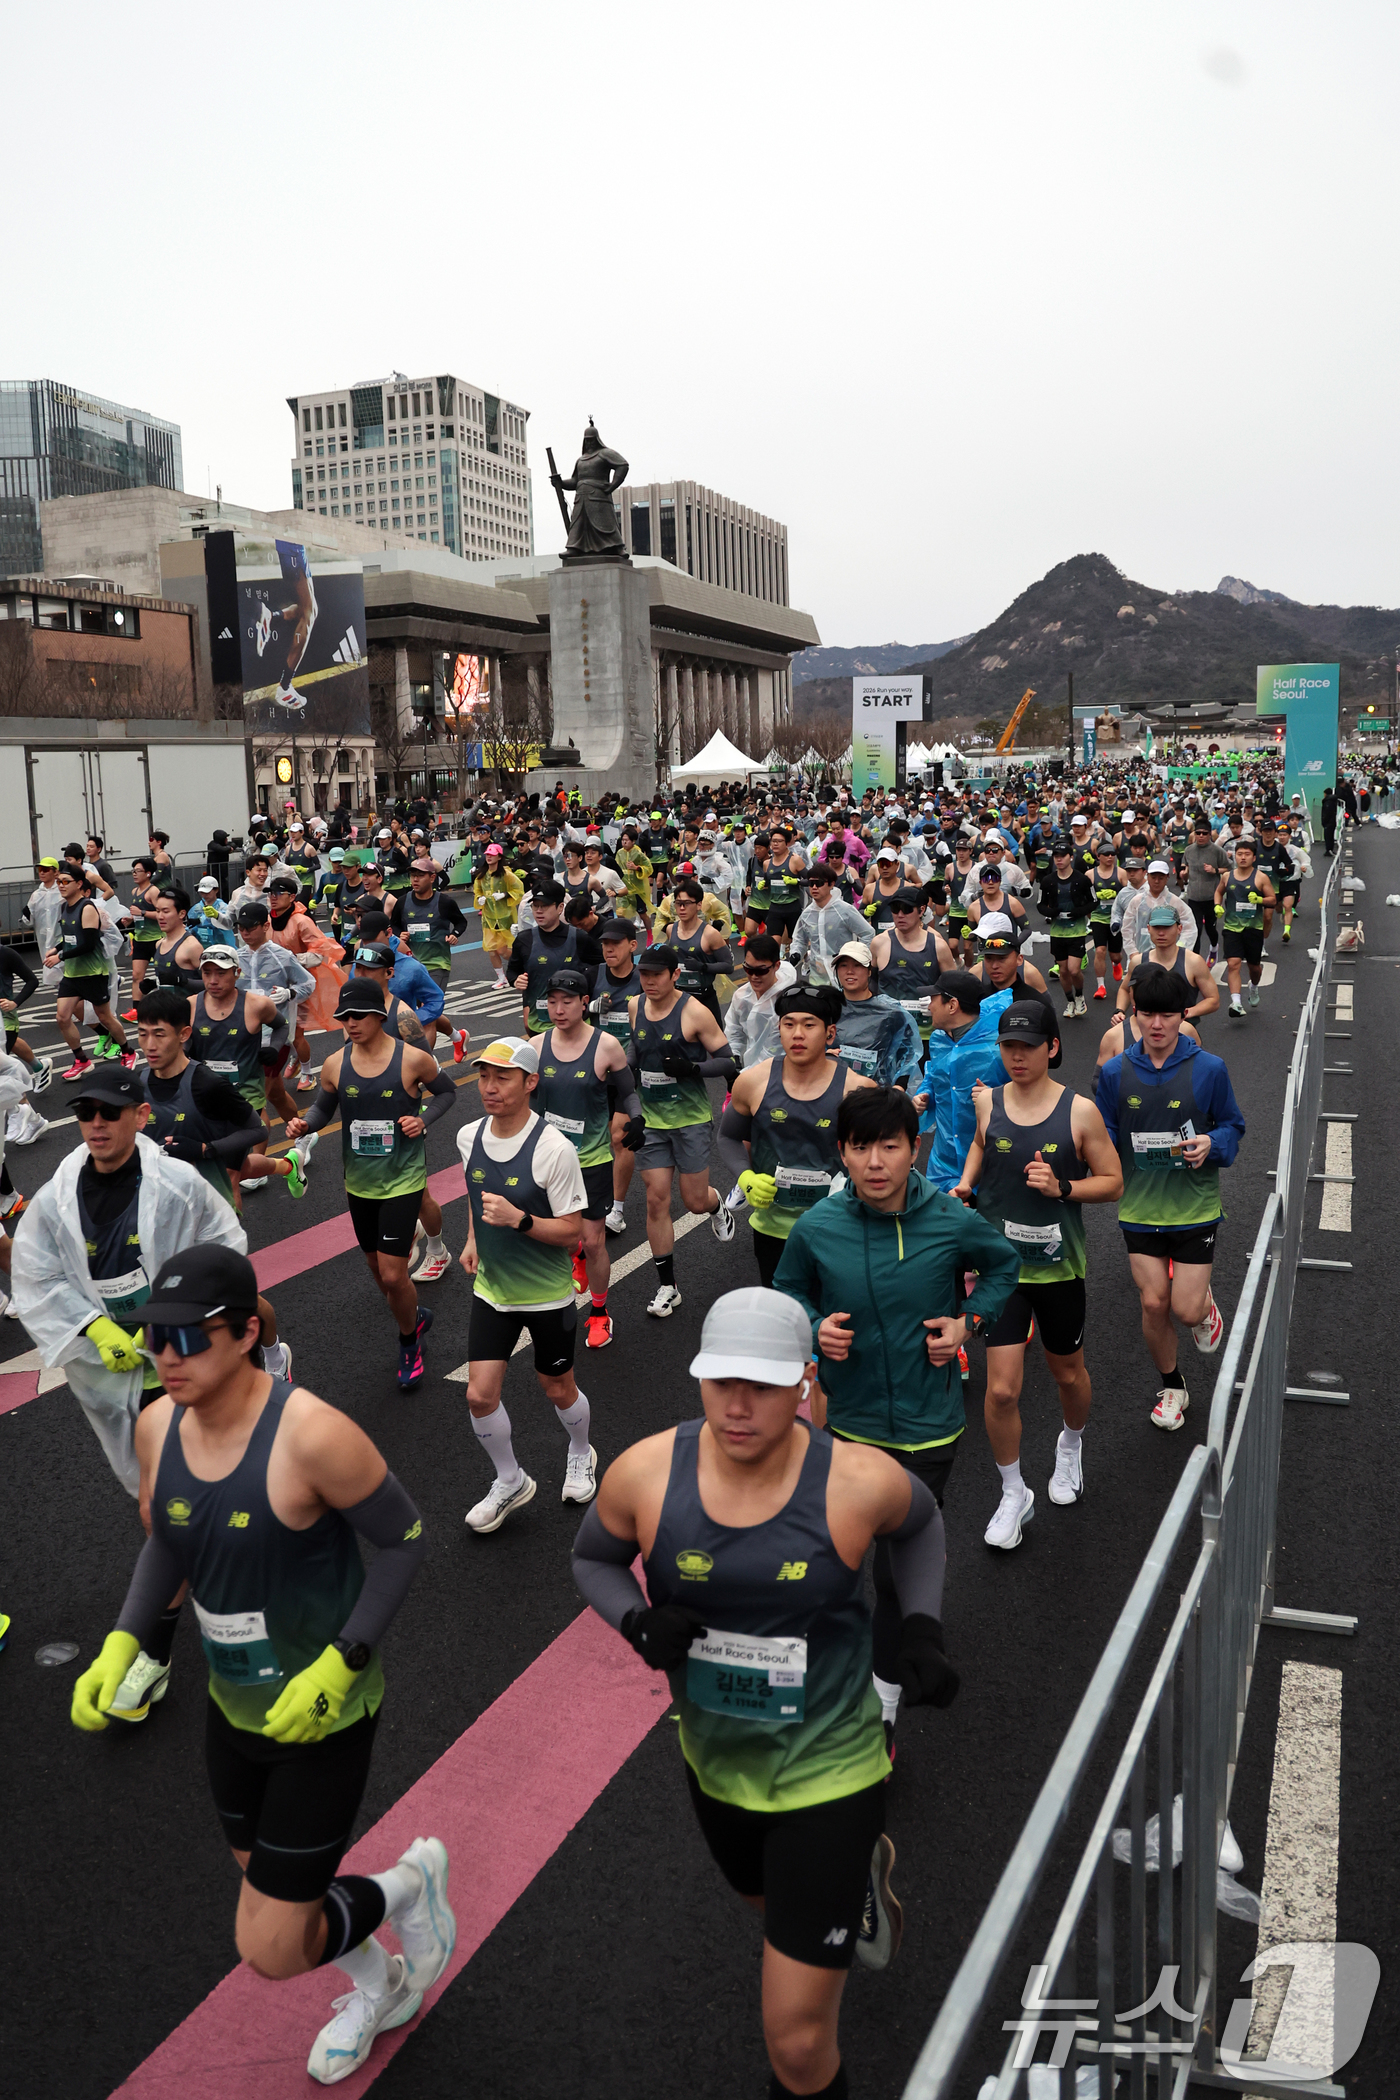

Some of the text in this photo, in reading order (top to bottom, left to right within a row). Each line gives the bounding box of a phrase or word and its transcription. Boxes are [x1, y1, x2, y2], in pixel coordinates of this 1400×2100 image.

[393, 382, 415, 393] 외교부
[1273, 678, 1330, 689] Half Race
[1272, 689, 1309, 699] Seoul.
[862, 695, 913, 707] START
[252, 707, 305, 719] THIS
[815, 1118, 831, 1128] NB
[1041, 1143, 1058, 1153] NB
[505, 1176, 519, 1186] NB
[228, 1511, 250, 1528] NB
[776, 1561, 808, 1581] NB
[225, 1627, 255, 1638] Seoul.
[701, 1644, 791, 1665] Half Race Seoul.
[722, 1695, 731, 1705] A
[823, 1927, 848, 1945] NB
